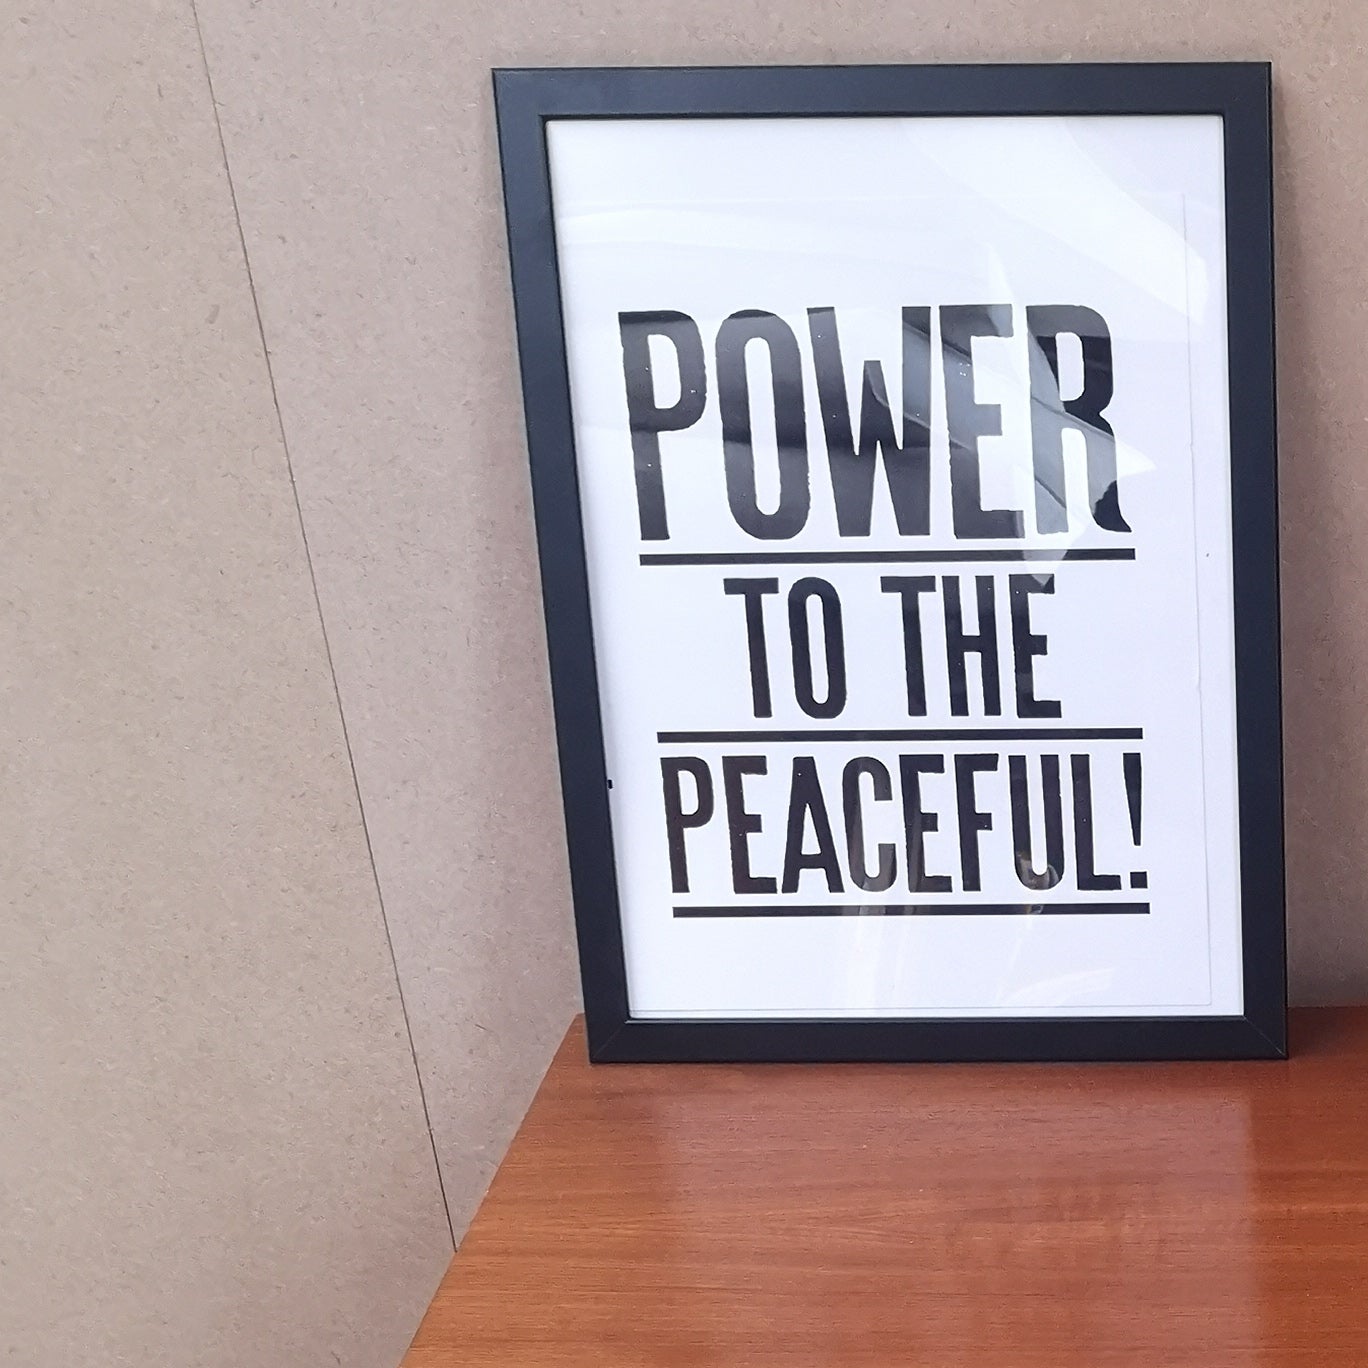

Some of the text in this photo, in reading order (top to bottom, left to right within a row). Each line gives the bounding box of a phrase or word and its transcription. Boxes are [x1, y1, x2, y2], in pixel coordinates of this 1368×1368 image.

[618, 305, 1132, 540] POWER
[724, 575, 1062, 719] TO THE
[661, 753, 1149, 894] PEACEFUL!
